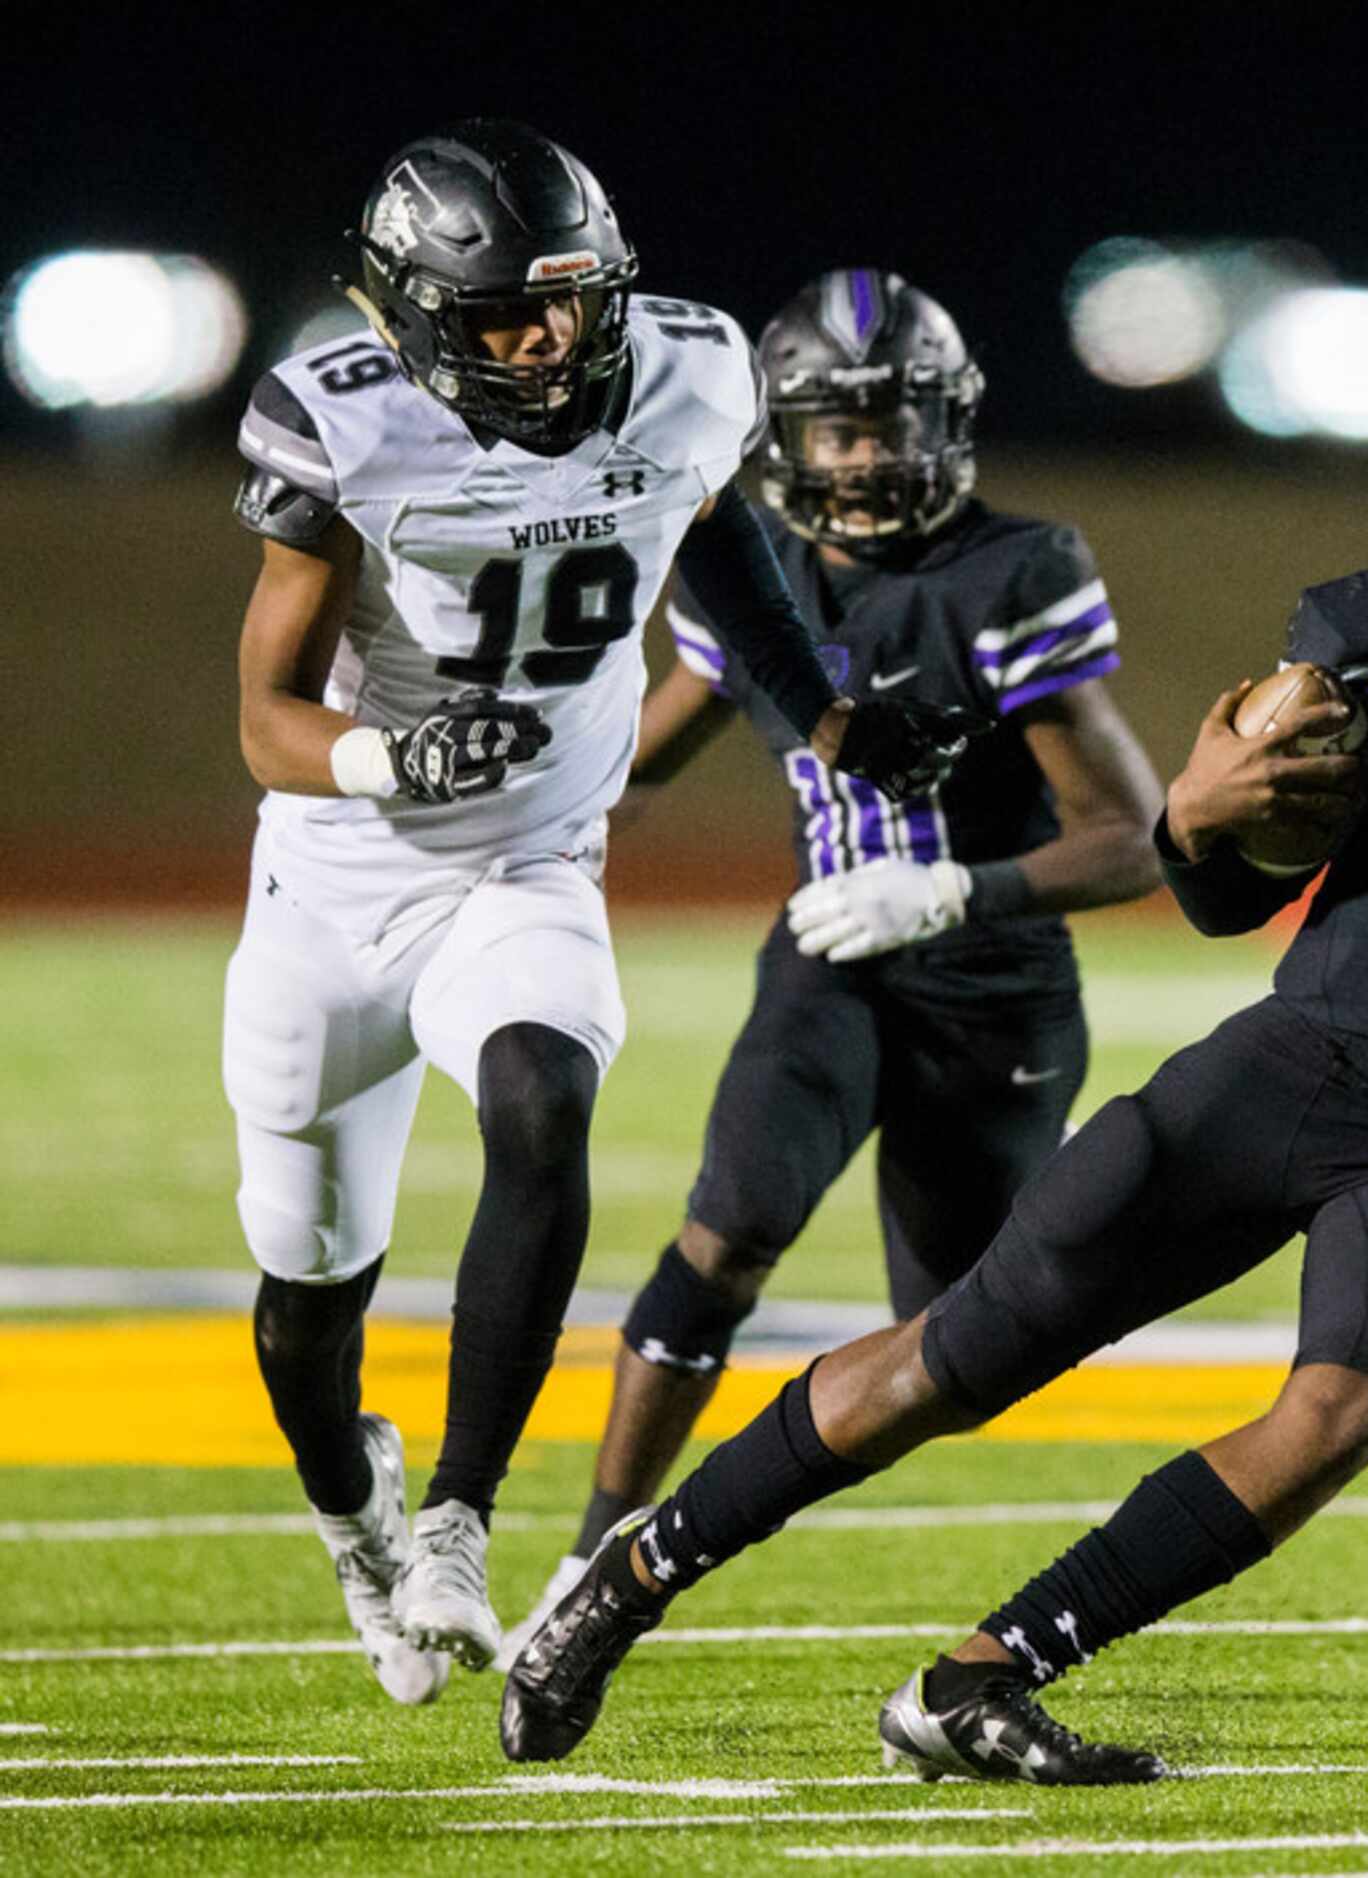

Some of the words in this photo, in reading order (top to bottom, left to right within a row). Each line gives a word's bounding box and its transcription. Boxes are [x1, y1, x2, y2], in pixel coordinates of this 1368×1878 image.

[305, 340, 399, 396] 19
[508, 513, 617, 550] WOLVES
[434, 542, 640, 689] 19
